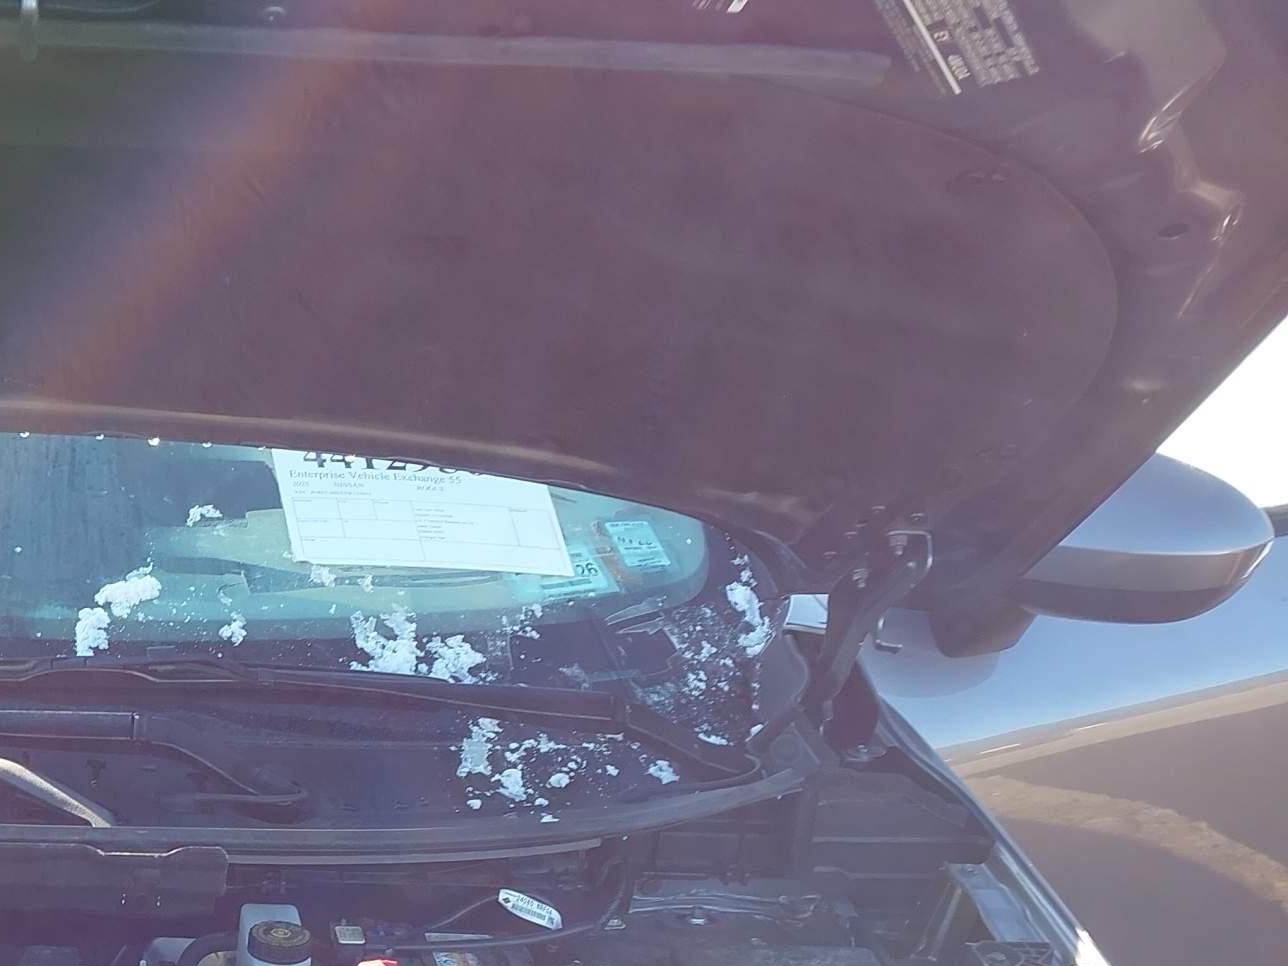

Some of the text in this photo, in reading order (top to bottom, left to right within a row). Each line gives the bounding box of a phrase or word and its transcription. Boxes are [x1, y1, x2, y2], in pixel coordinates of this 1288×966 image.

[289, 469, 346, 481] Enterprise
[349, 470, 391, 482] Vehicle
[393, 474, 446, 485] Exchange
